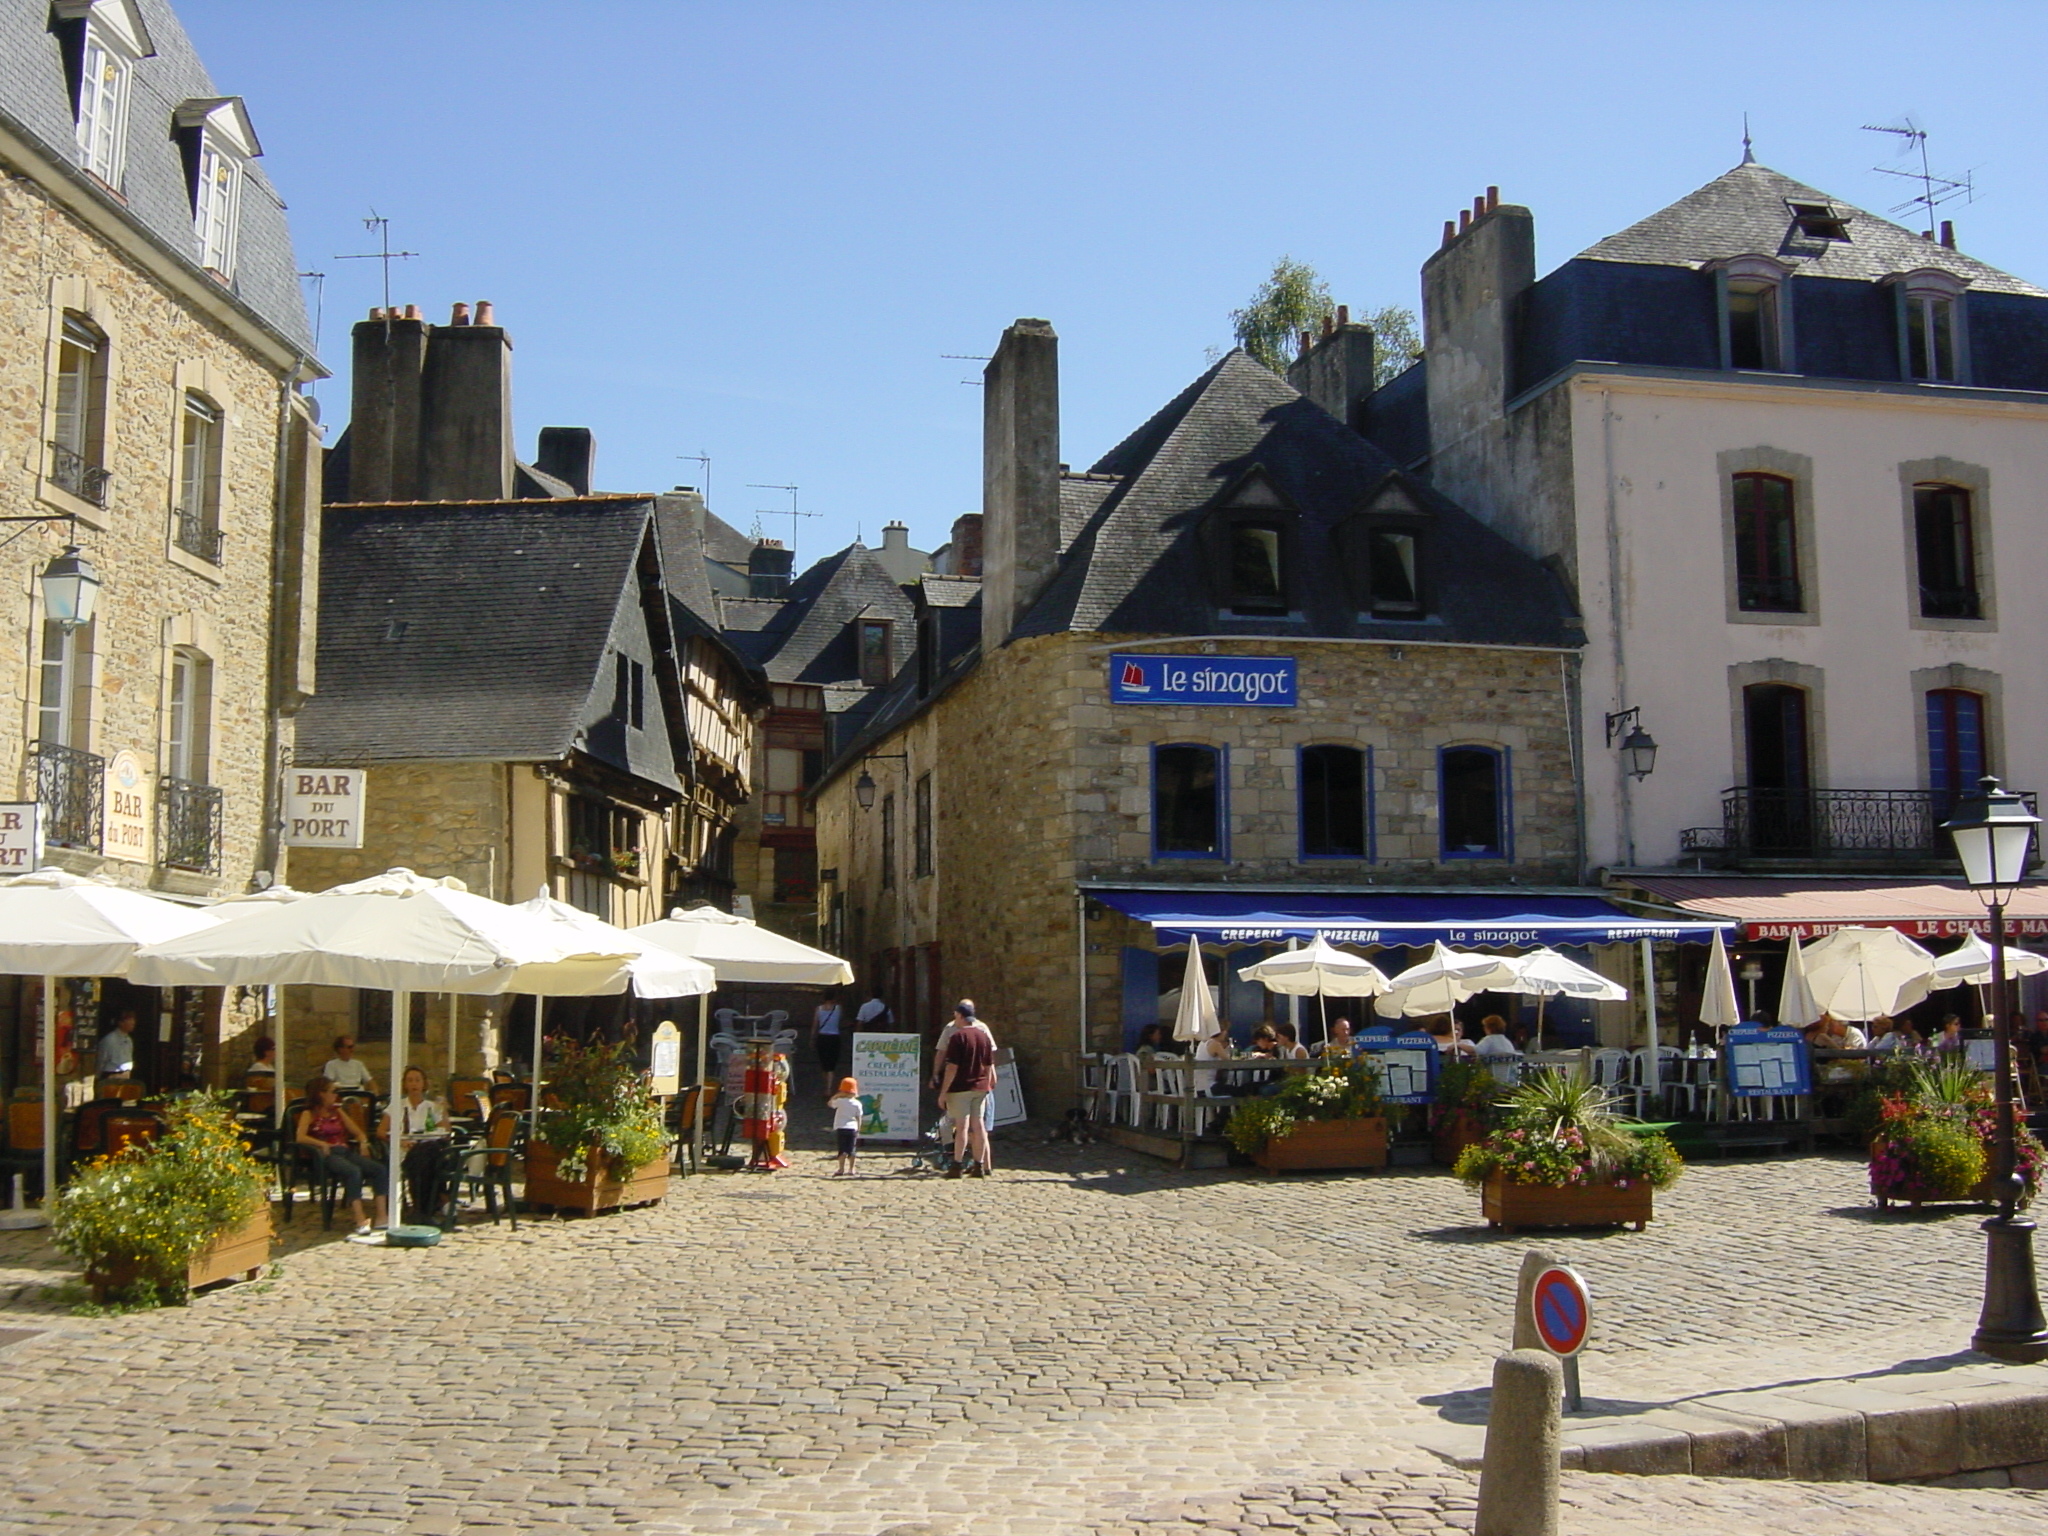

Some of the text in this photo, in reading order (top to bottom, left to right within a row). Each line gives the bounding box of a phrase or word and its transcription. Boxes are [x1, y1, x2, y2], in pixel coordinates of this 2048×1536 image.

[1163, 663, 1289, 702] Le sinagot
[297, 775, 351, 796] BAR
[113, 791, 143, 818] BAR
[312, 802, 335, 813] DU
[107, 821, 144, 848] du PORT
[292, 818, 350, 837] PORT
[1758, 925, 1790, 937] BAR
[1917, 921, 1939, 934] LE
[1945, 920, 2015, 934] CHASE
[1221, 929, 1380, 942] CREPERIE PIZZERIA
[1450, 930, 1539, 944] Le sinagot
[1607, 929, 1681, 940] RESTAURANT
[1397, 1037, 1433, 1045] PIZZERIA
